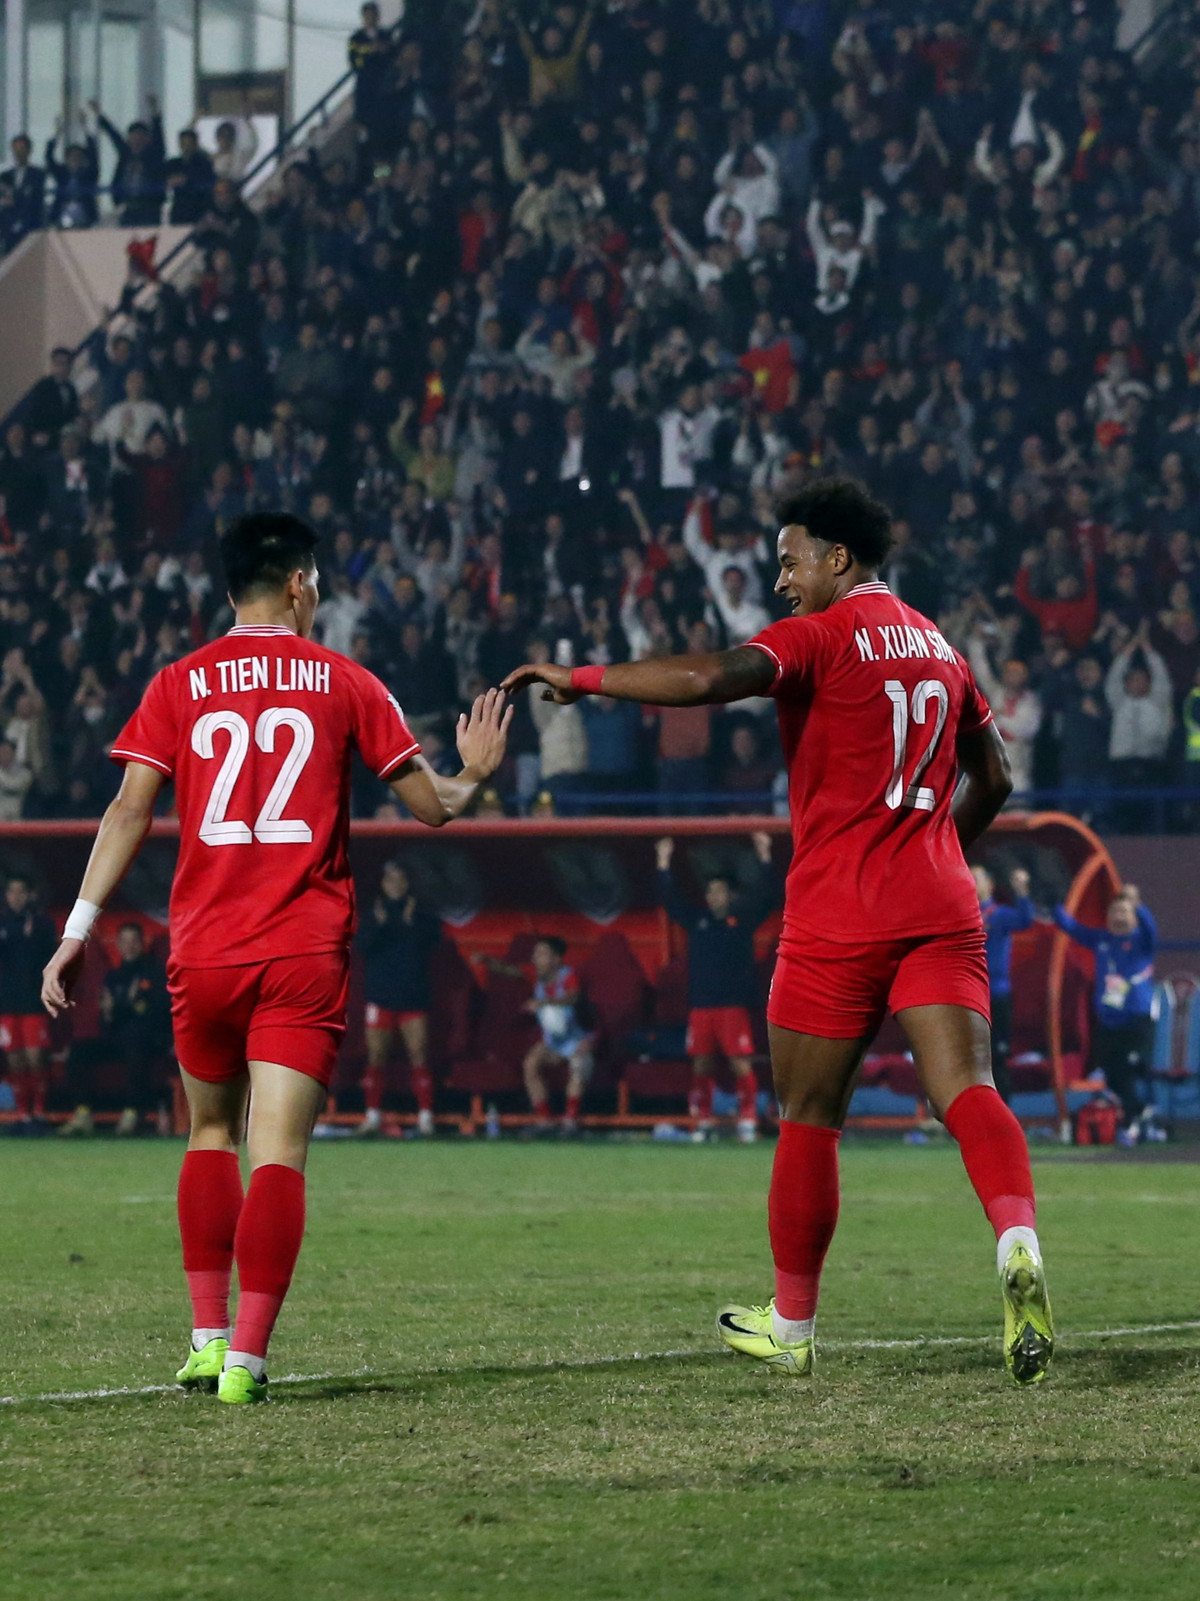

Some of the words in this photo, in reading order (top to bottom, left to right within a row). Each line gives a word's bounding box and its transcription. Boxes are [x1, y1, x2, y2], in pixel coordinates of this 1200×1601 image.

[189, 667, 212, 700] N.
[216, 656, 268, 693] TIEN
[276, 657, 331, 694] LINH
[855, 627, 880, 662] N.
[878, 625, 931, 660] XUAN
[191, 707, 314, 846] 22
[884, 679, 949, 812] 12
